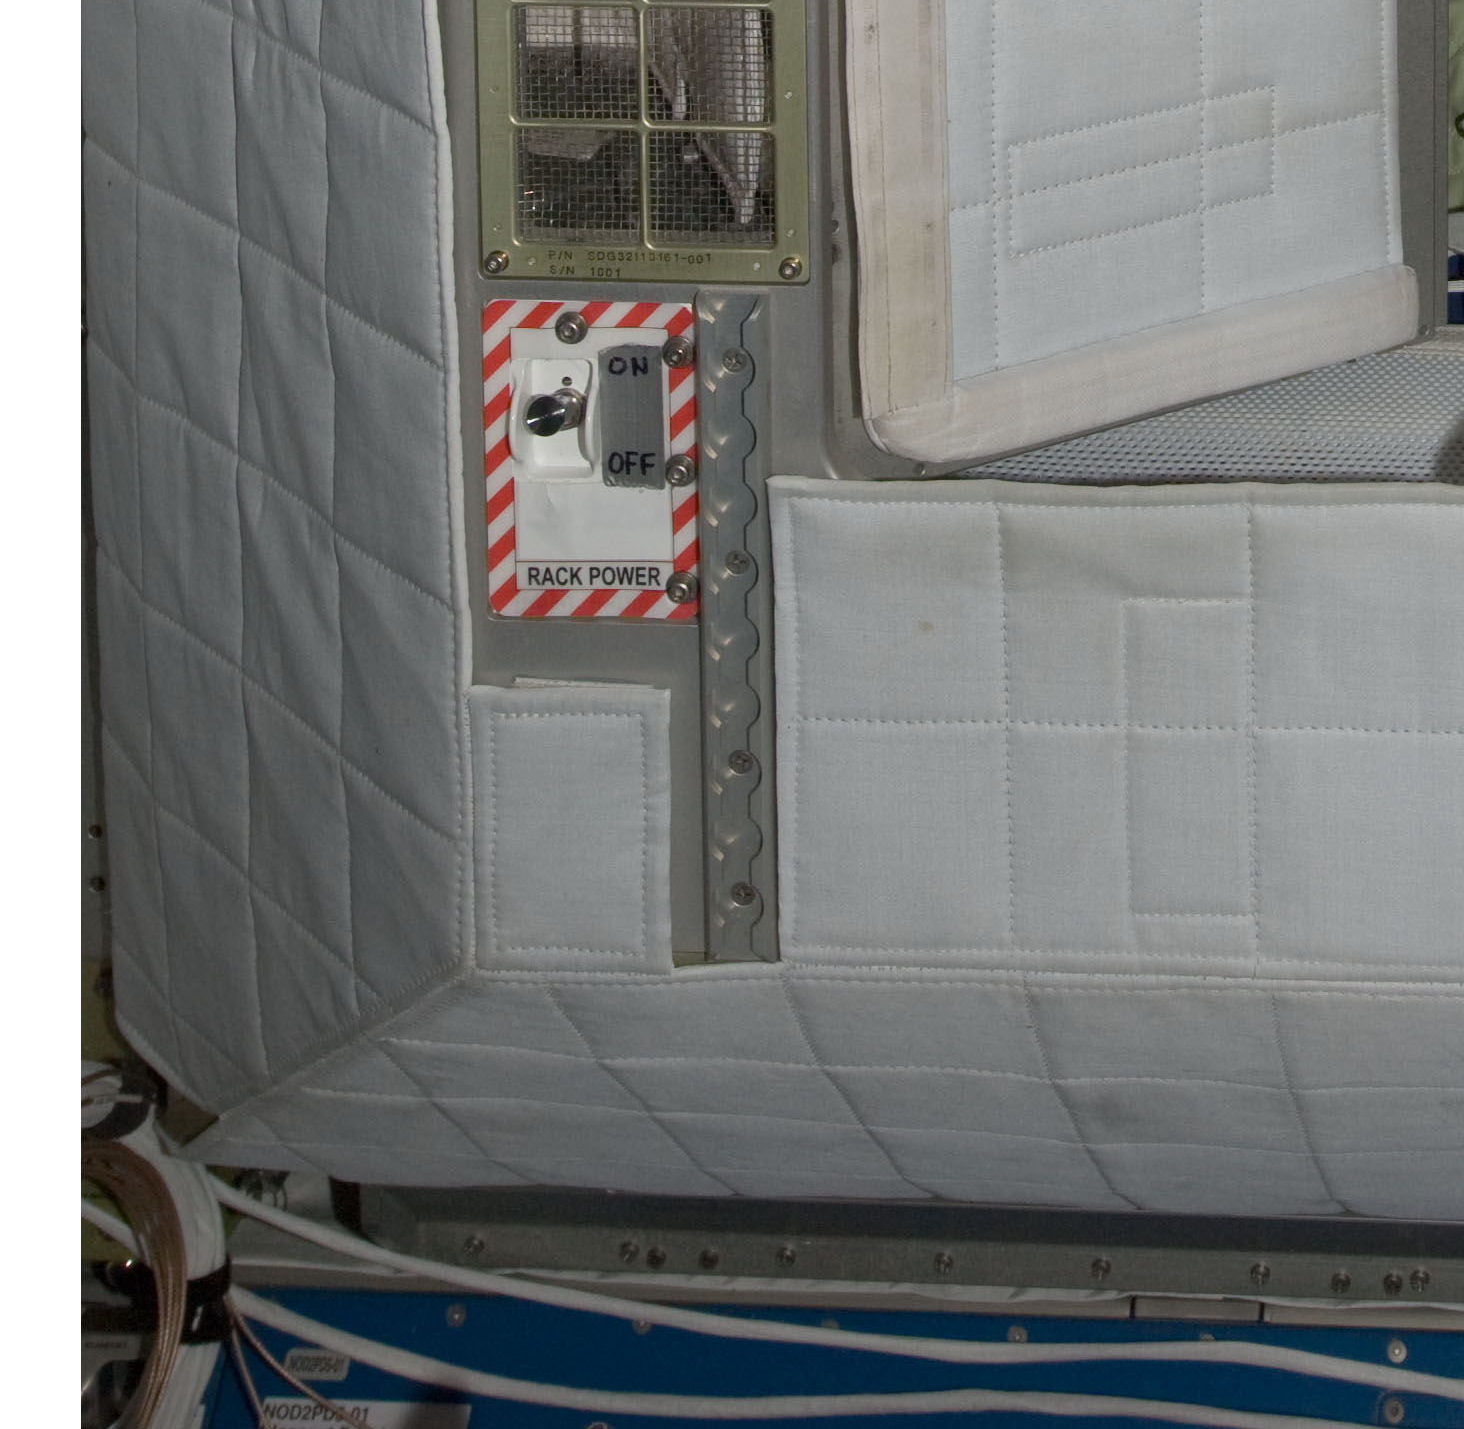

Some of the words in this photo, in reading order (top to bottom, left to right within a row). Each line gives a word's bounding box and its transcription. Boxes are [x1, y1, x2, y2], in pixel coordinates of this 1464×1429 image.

[548, 250, 573, 260] P/N
[588, 250, 712, 264] SDG32110161-001
[550, 265, 575, 275] S/N
[590, 267, 622, 278] 1001
[608, 354, 651, 377] ON
[607, 451, 657, 477] OFF
[526, 565, 582, 587] RACK
[588, 564, 662, 587] POWER
